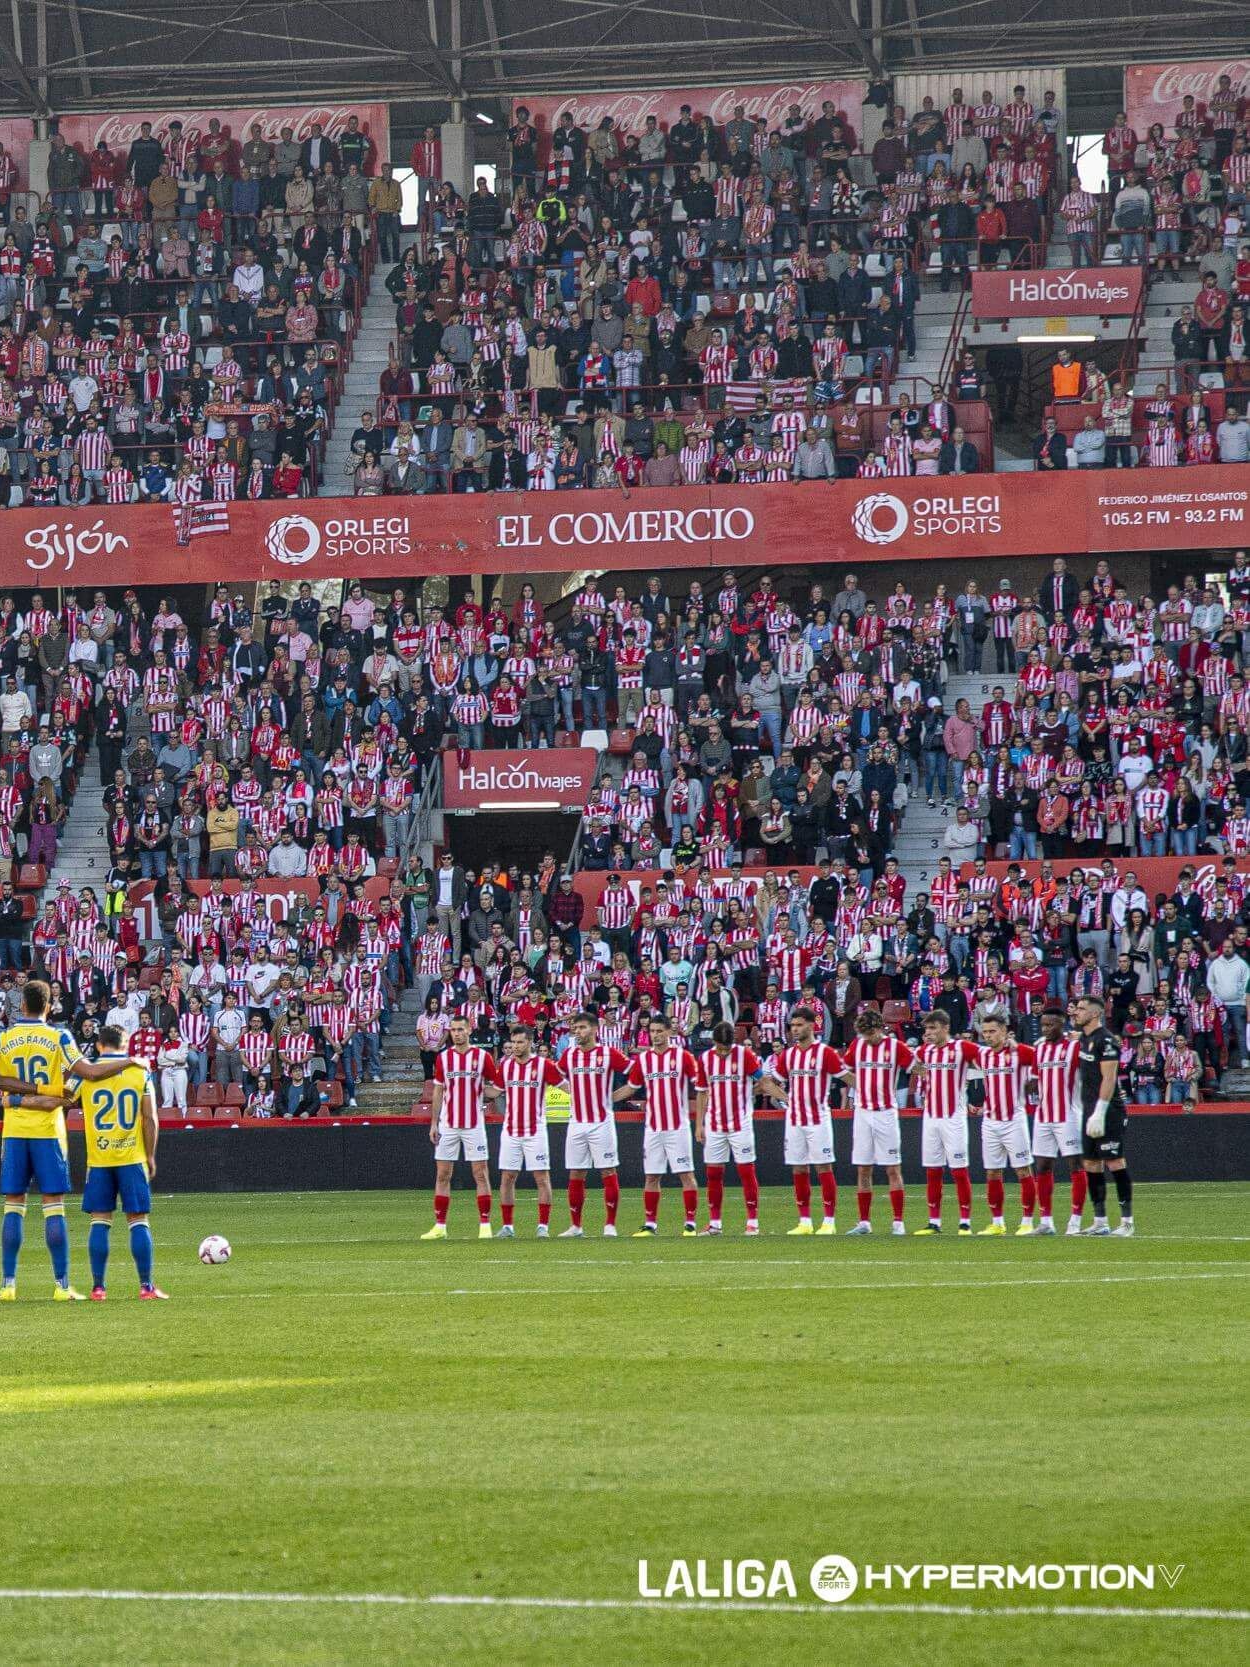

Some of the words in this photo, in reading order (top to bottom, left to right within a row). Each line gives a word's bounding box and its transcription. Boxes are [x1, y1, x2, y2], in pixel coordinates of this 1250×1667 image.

[1010, 270, 1087, 301] Halcón
[1087, 282, 1129, 303] viajes
[913, 495, 1000, 516] ORLEGI
[1098, 495, 1148, 505] FEDERICO
[1150, 492, 1192, 504] JIMÉNEZ
[1194, 491, 1247, 502] LOSANTOS
[913, 515, 1002, 535] SPORTS
[1102, 512, 1143, 525] 105.2
[1147, 510, 1170, 524] FM
[1184, 509, 1216, 523] 93.2
[1220, 508, 1244, 522] FM
[325, 517, 409, 537] ORLEGI
[496, 515, 543, 547] EL
[549, 507, 755, 545] COMERCIO
[25, 519, 129, 570] gijón
[325, 537, 411, 556] SPORTS
[459, 759, 539, 791] Halcón
[539, 775, 582, 793] viajes
[940, 808, 949, 817] 4
[96, 827, 104, 837] 4
[931, 839, 939, 849] 3
[87, 858, 95, 867] 3
[919, 871, 928, 881] 2
[26, 1036, 57, 1052] RAMOS
[12, 1056, 50, 1086] 16
[92, 1088, 139, 1131] 20
